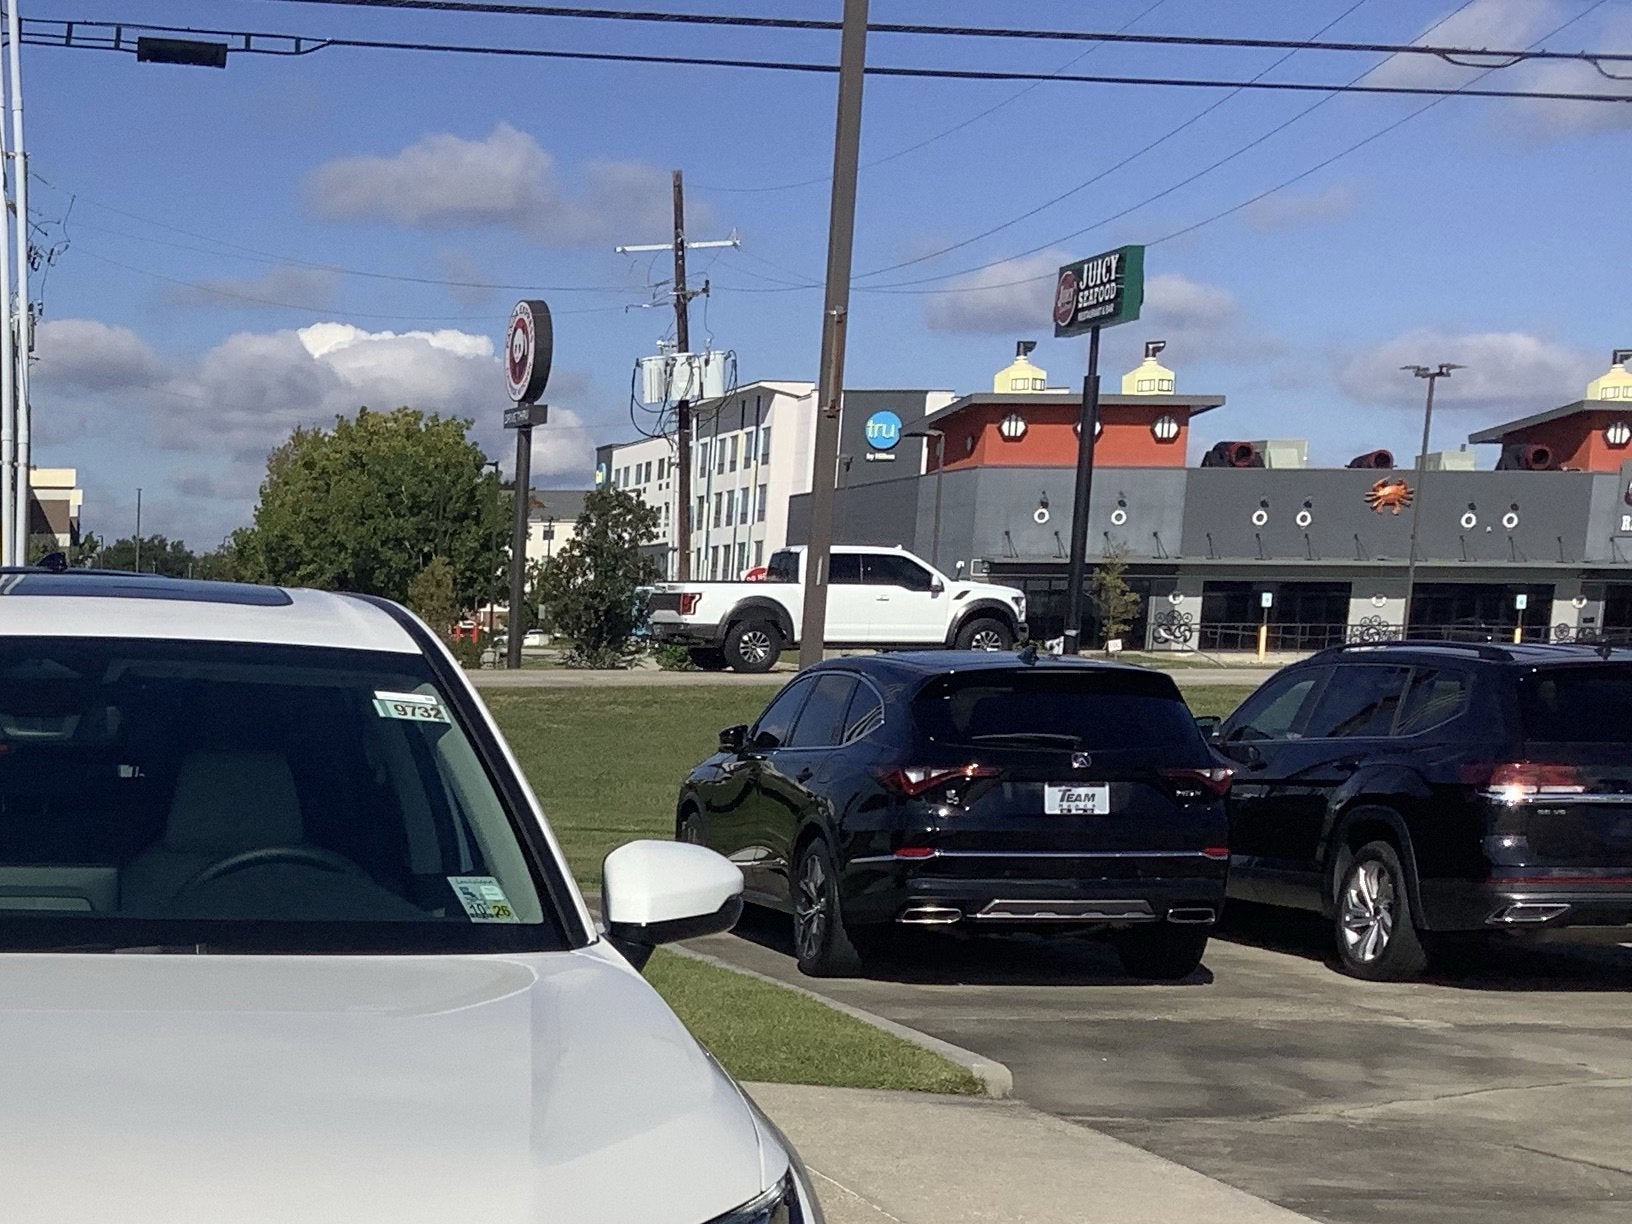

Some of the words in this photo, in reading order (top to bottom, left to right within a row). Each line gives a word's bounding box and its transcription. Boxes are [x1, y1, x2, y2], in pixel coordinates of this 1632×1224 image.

[1079, 253, 1120, 290] JUICY
[1077, 281, 1117, 309] SEAFOOD
[867, 418, 896, 439] tru
[393, 703, 445, 720] 9732
[1058, 788, 1096, 803] TEAM
